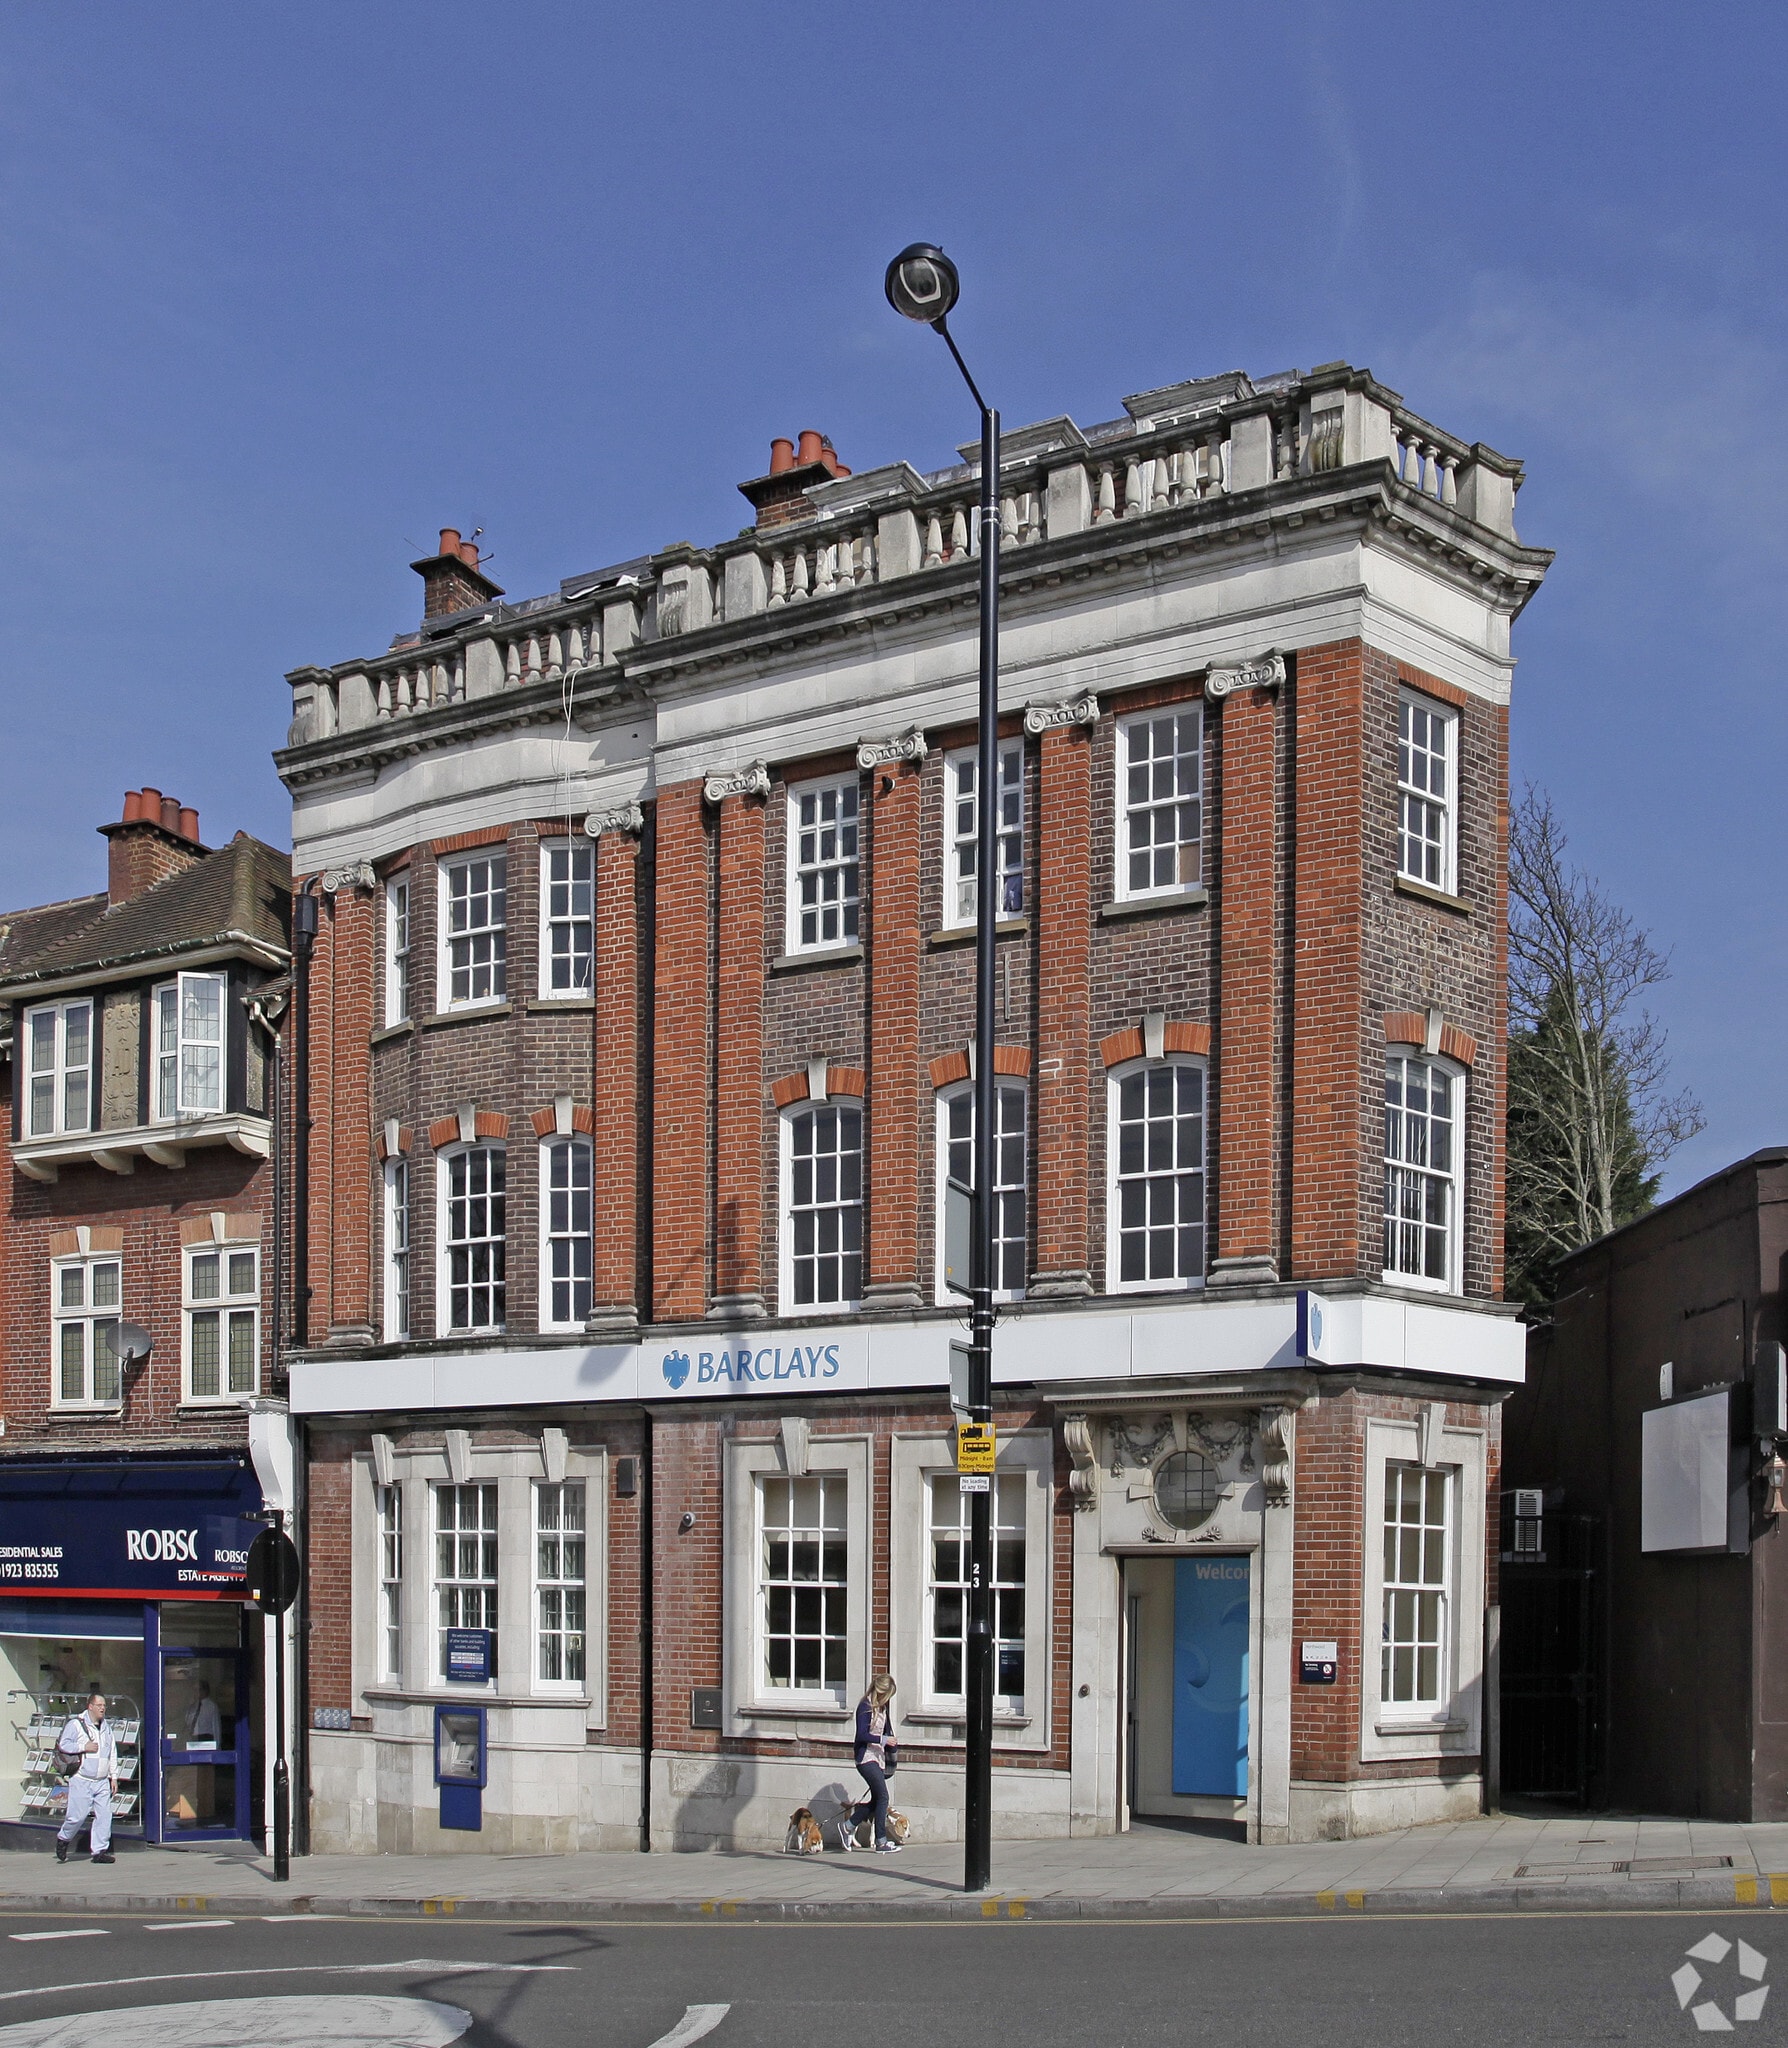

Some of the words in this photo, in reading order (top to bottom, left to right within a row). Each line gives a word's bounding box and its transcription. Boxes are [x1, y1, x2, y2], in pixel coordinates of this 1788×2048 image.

[697, 1345, 839, 1383] BARCLAYS
[0, 1546, 40, 1558] SIDENTIAL
[41, 1546, 63, 1558] SALES
[0, 1562, 23, 1578] 1923
[24, 1562, 59, 1578] 835355
[177, 1569, 208, 1582] ESTATE
